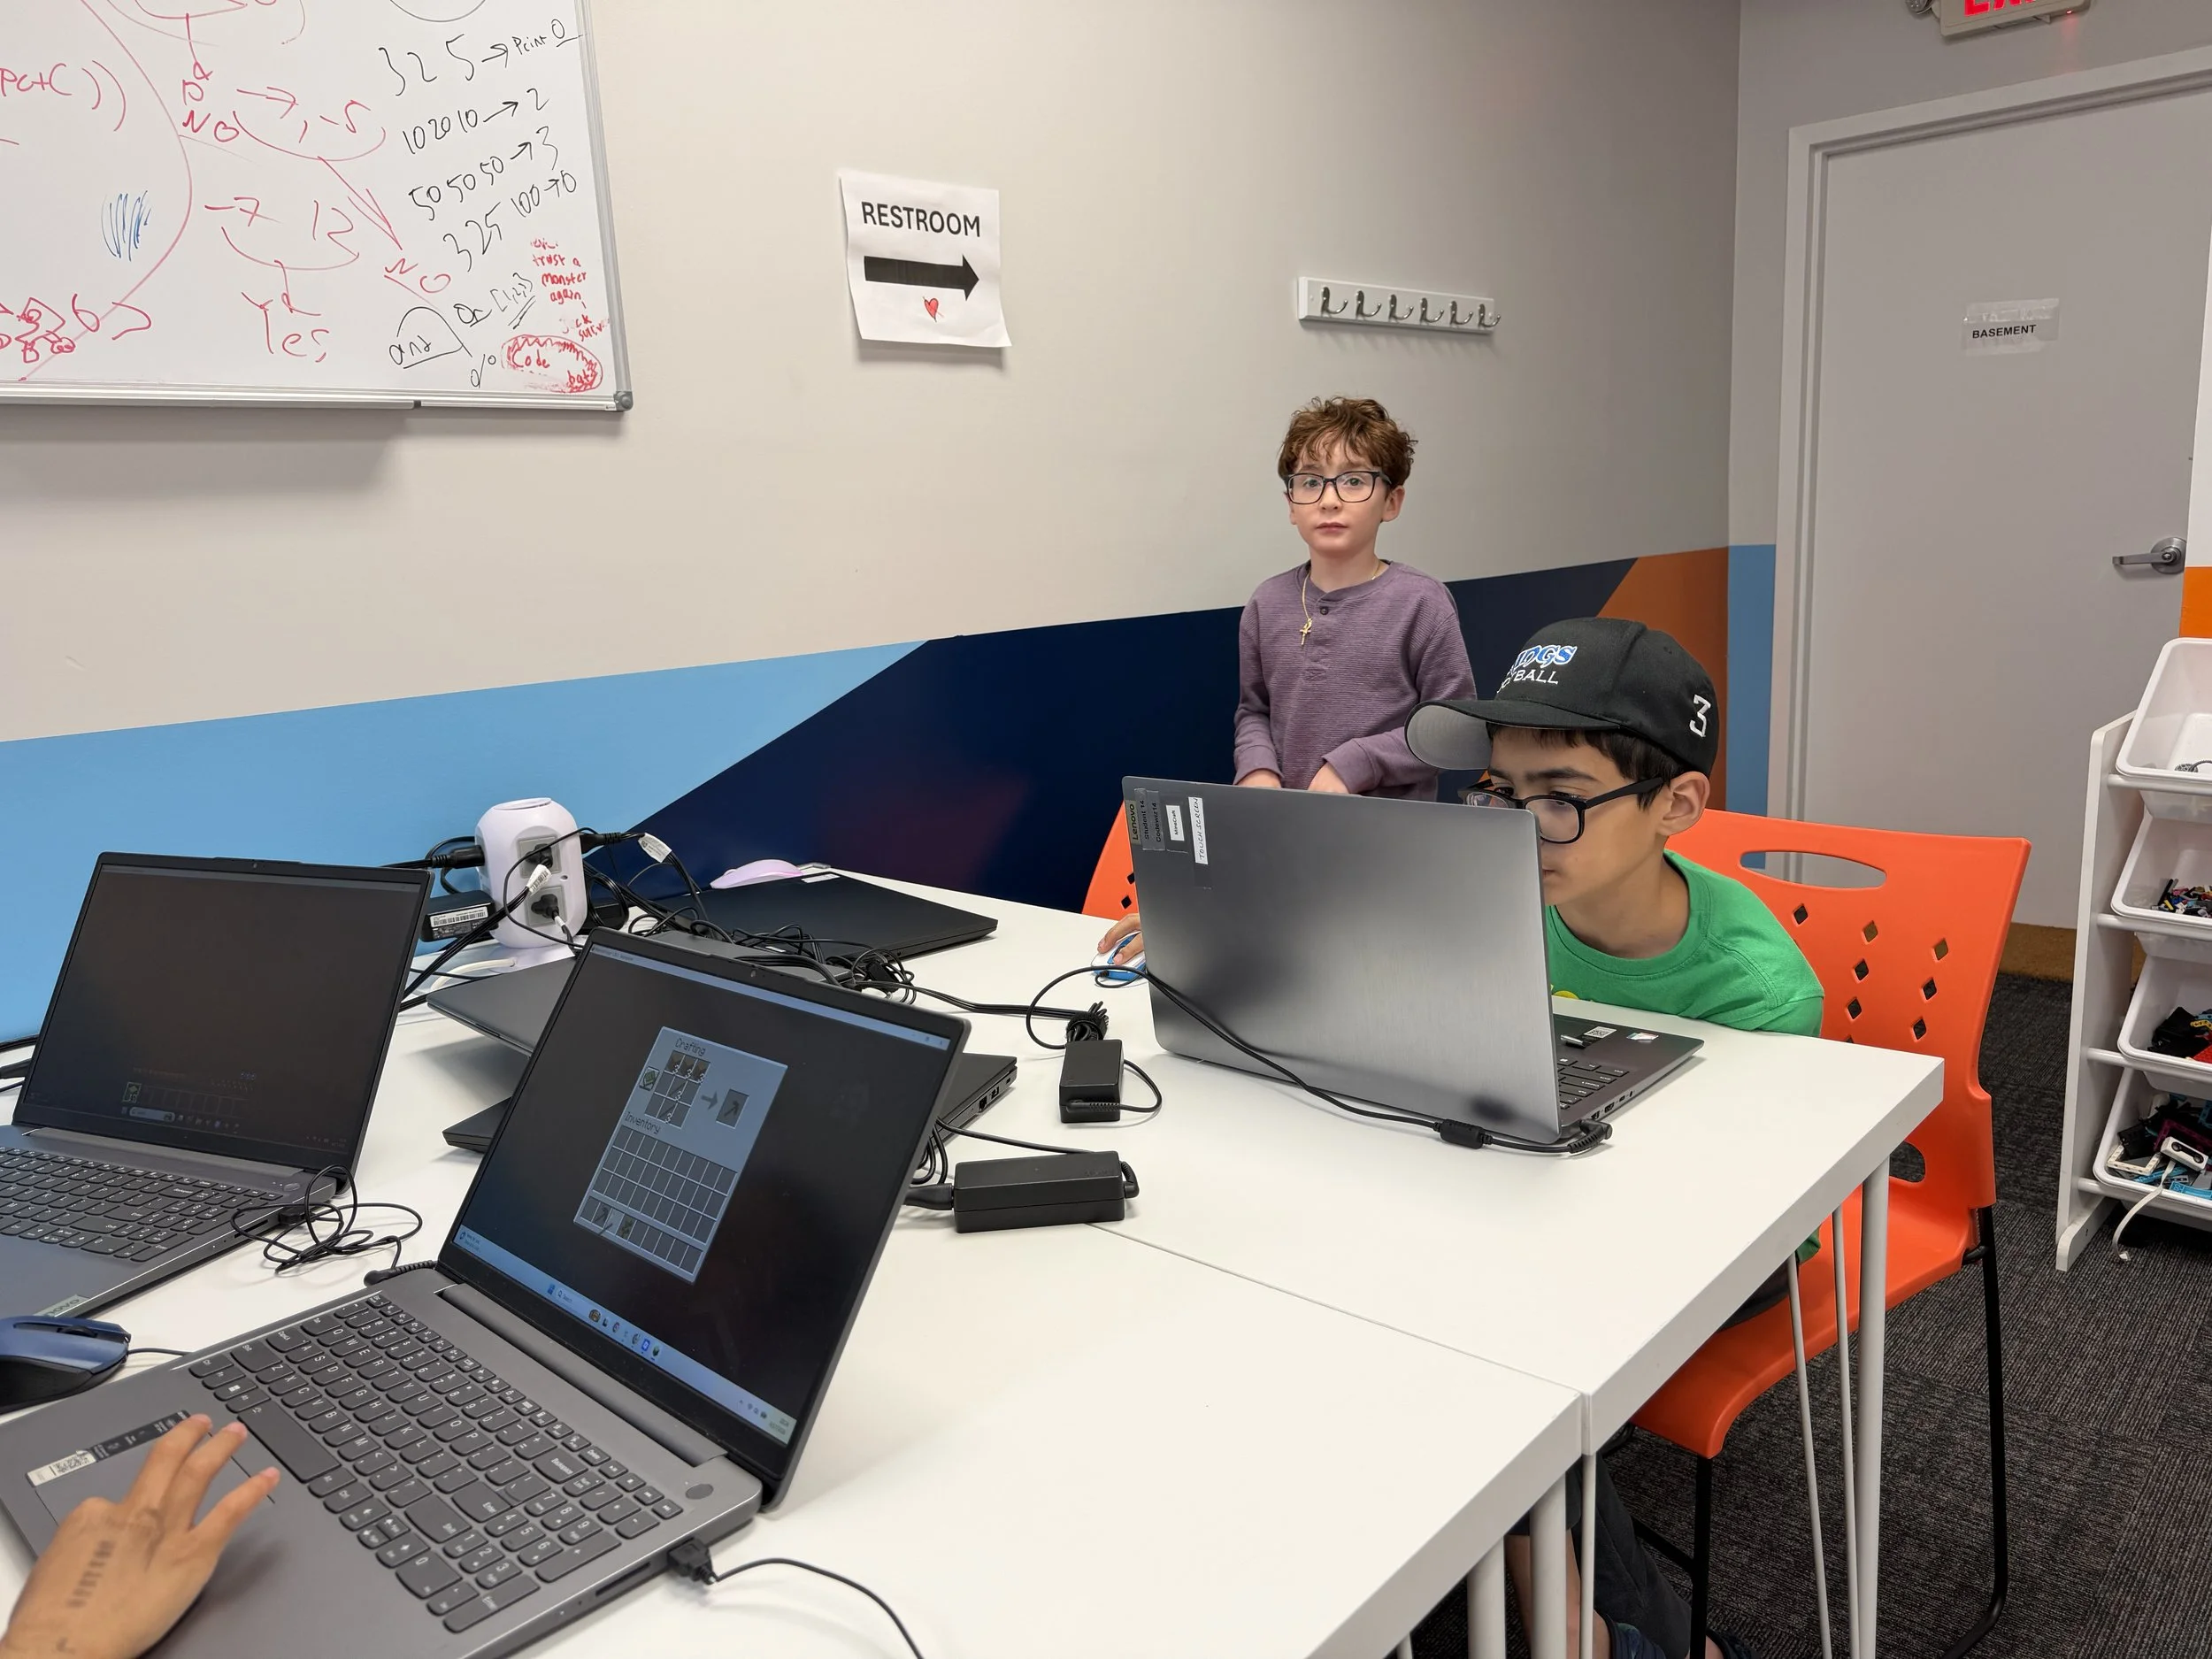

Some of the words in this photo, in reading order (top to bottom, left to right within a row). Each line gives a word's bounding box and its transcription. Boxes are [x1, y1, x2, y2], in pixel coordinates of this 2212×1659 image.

[378, 47, 406, 96] 3
[407, 51, 437, 82] 2
[445, 34, 474, 81] 5
[526, 88, 549, 111] 2
[408, 185, 442, 221] 50
[446, 173, 476, 203] 50
[480, 156, 504, 187] 50
[861, 201, 981, 238] RESTROOM
[533, 254, 565, 267] trust
[1971, 324, 2037, 339] BASEMENT
[1689, 694, 1712, 738] 3
[1129, 803, 1139, 841] Lenovo
[1141, 810, 1150, 840] Student
[1196, 831, 1205, 861] TOUCH
